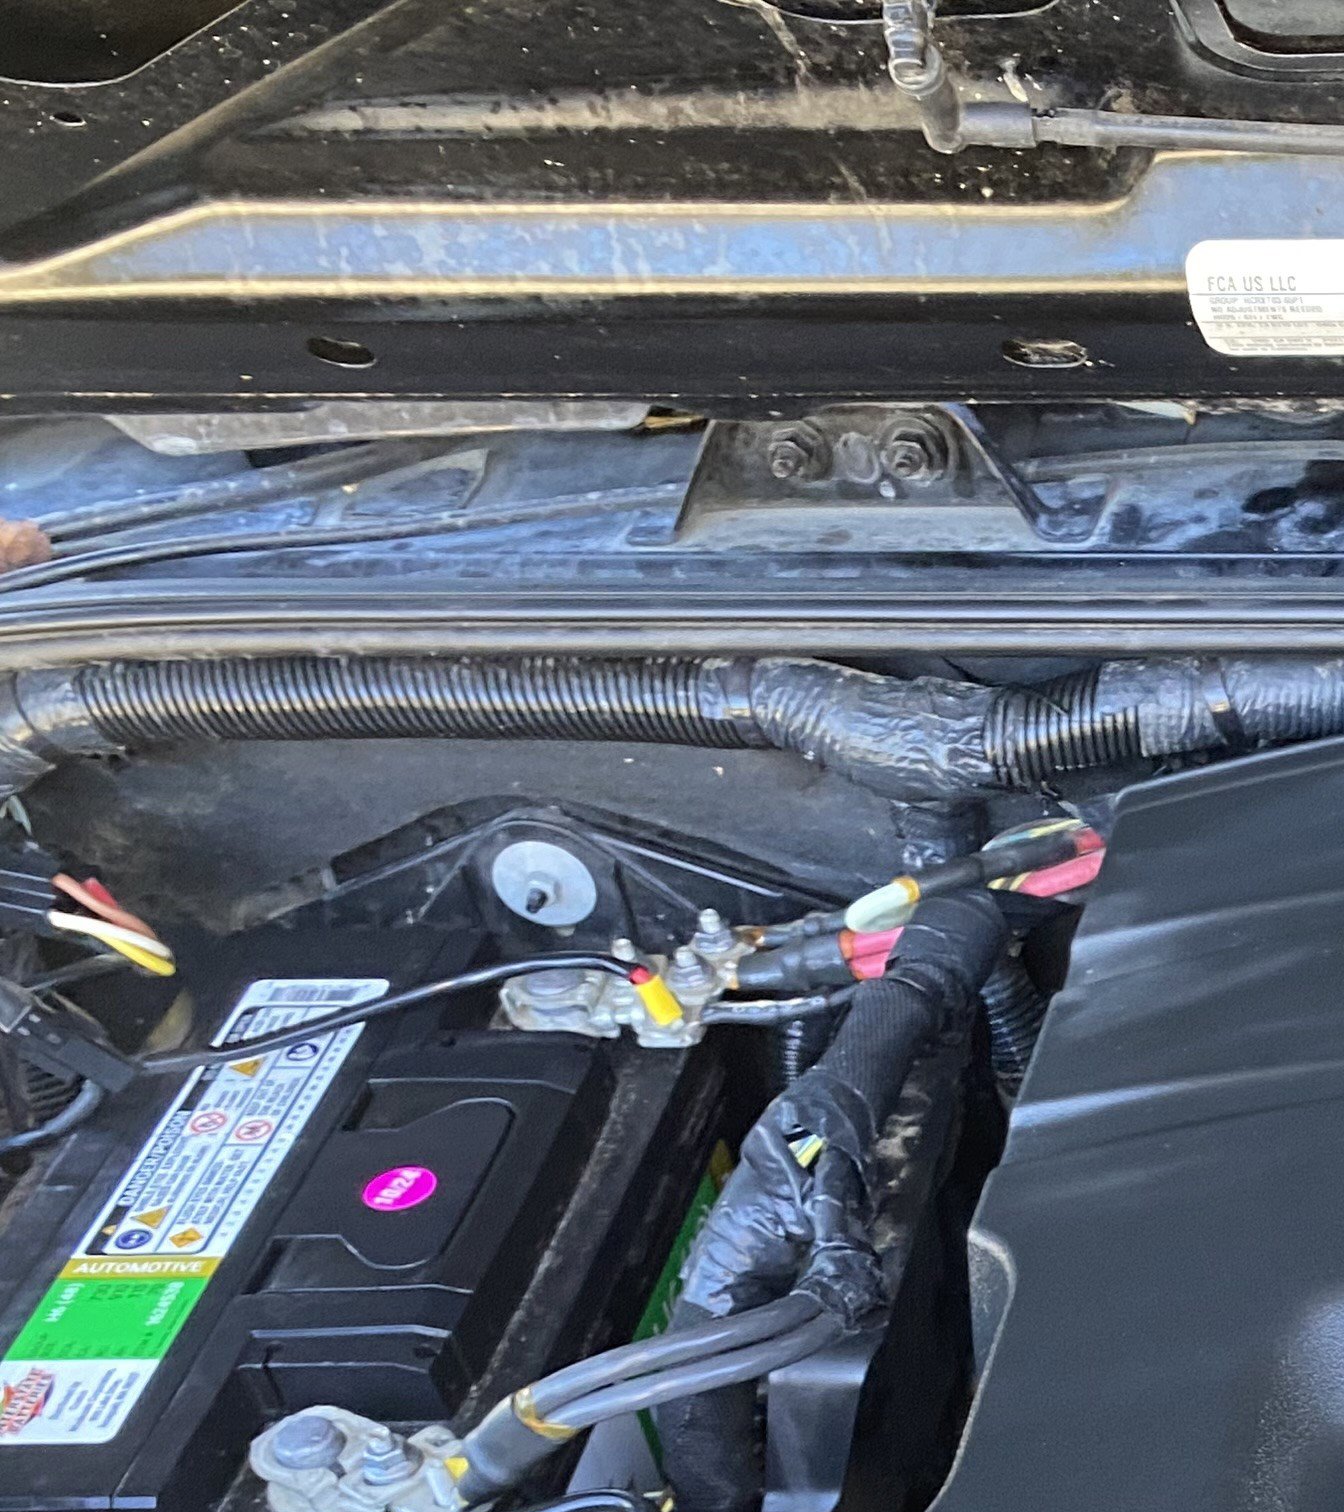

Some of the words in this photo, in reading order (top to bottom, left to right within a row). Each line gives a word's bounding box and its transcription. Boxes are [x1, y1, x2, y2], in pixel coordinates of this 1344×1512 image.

[1207, 276, 1238, 292] FCA
[1242, 276, 1263, 292] US
[1269, 276, 1297, 292] LLC
[116, 1110, 192, 1206] DANGER/POISON
[72, 1260, 207, 1275] AUTOMOTIVE
